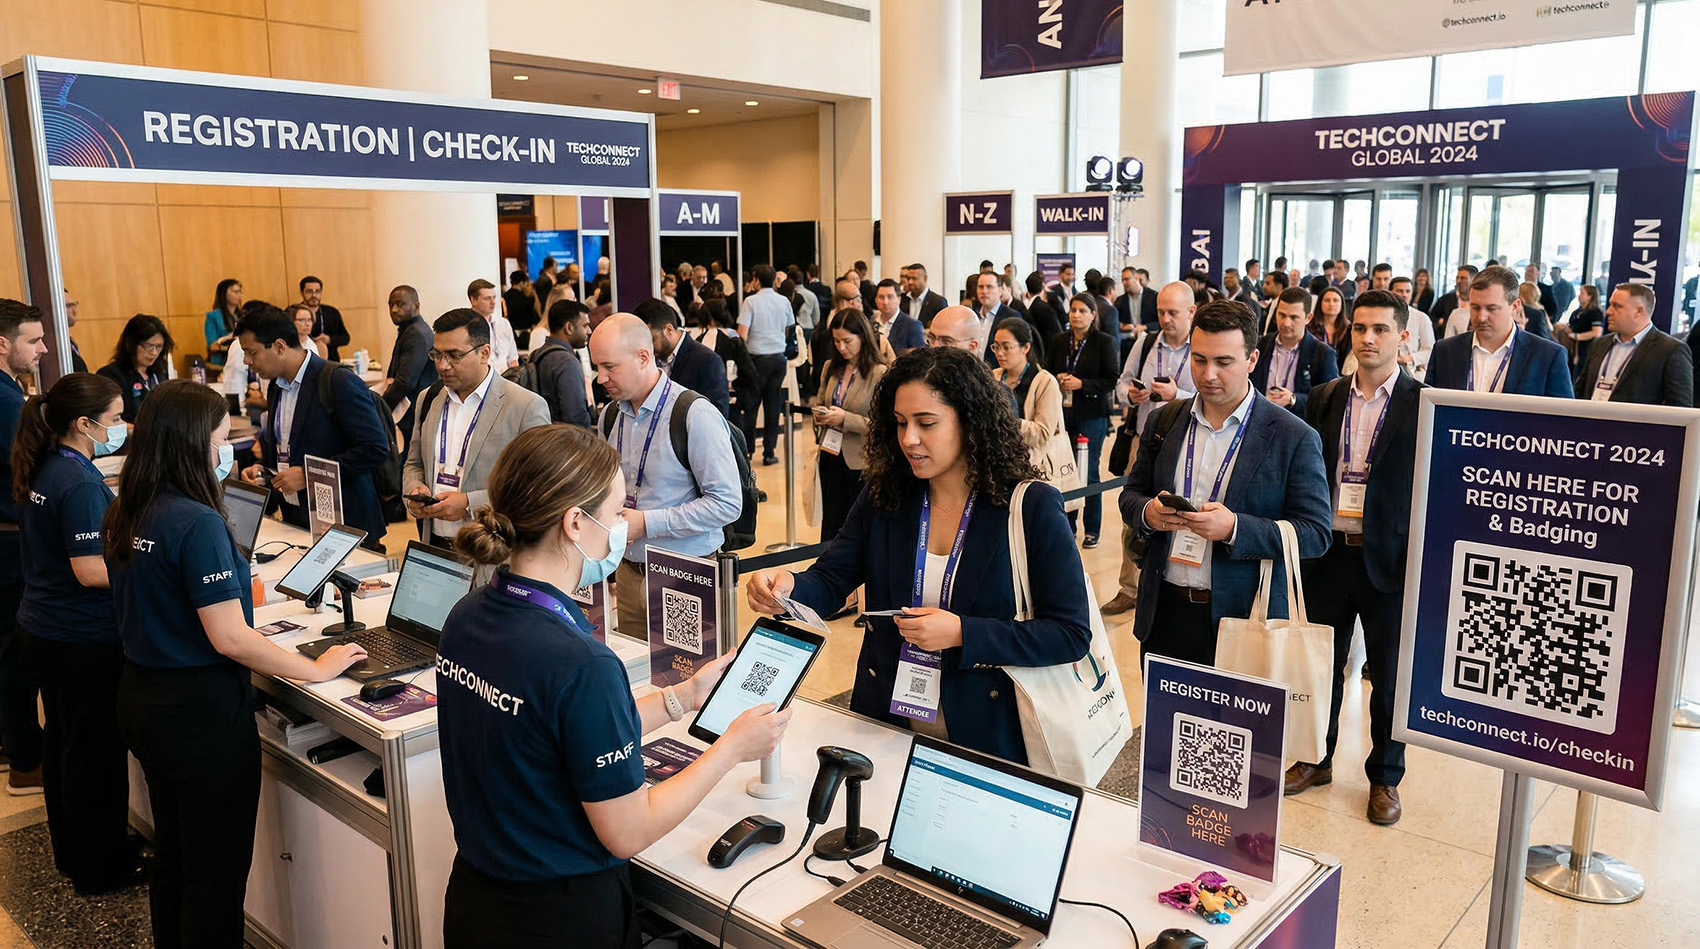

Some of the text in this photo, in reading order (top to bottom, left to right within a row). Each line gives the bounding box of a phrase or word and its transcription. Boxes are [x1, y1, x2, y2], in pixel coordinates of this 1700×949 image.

[143, 110, 400, 156] REGISTRATION
[422, 129, 556, 164] CHECK-IN
[1315, 118, 1506, 150] TECHCONNECT
[566, 141, 641, 159] TECHCONNECT
[580, 154, 630, 167] GLOBAL 2024
[1351, 145, 1478, 167] GLOBAL 2024
[677, 202, 720, 225] A-M
[959, 202, 997, 225] N-Z
[1041, 207, 1104, 222] WALK-IN
[1448, 428, 1665, 467] TECHCONNECT 2024
[1462, 466, 1639, 503] SCAN HERE FOR
[1465, 488, 1629, 526] REGISTRATION
[1488, 514, 1599, 549] & Badging
[202, 569, 233, 584] STAFF
[650, 562, 713, 588] SCAN BADGE HERE
[1160, 679, 1271, 716] REGISTER NOW
[897, 705, 930, 719] ATTENDEE
[1420, 705, 1635, 773] techconnect.io/checkin
[596, 741, 635, 768] STAFF
[1192, 804, 1228, 823] SCAN
[1186, 815, 1232, 836] BADGE
[1191, 828, 1225, 847] HERE
